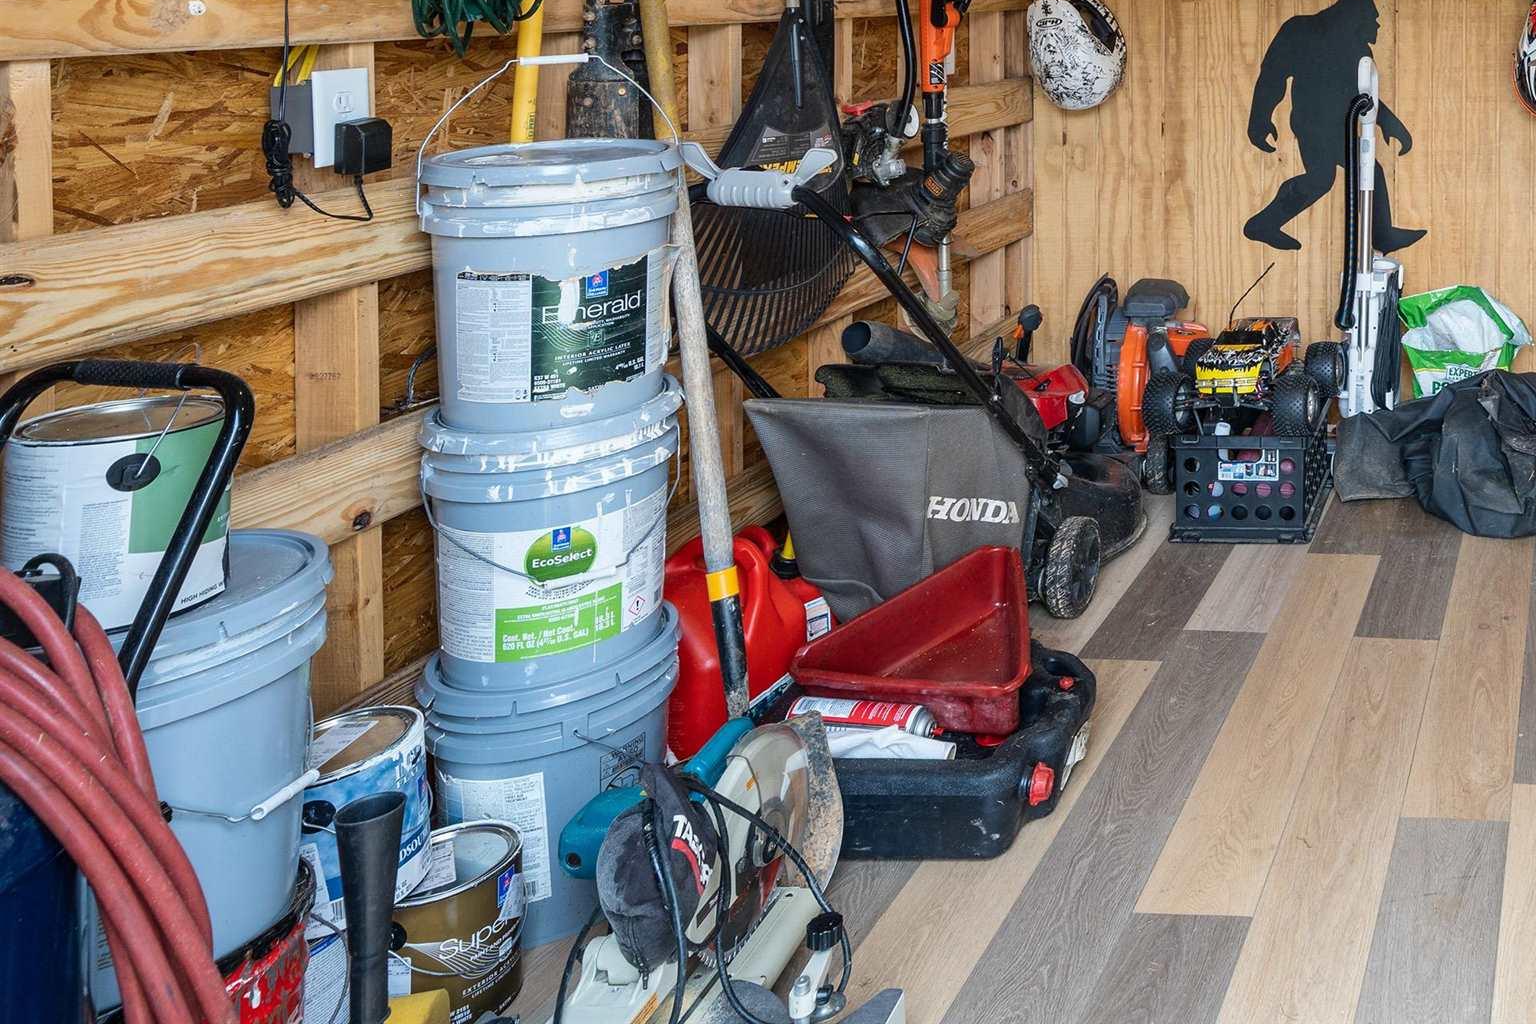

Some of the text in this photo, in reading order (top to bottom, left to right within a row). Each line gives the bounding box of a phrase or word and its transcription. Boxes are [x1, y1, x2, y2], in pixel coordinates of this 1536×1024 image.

[1448, 367, 1479, 378] EXPERT
[927, 496, 1020, 524] HONDA
[532, 548, 593, 569] EcoSelect
[502, 642, 516, 651] 620
[516, 641, 526, 650] FL
